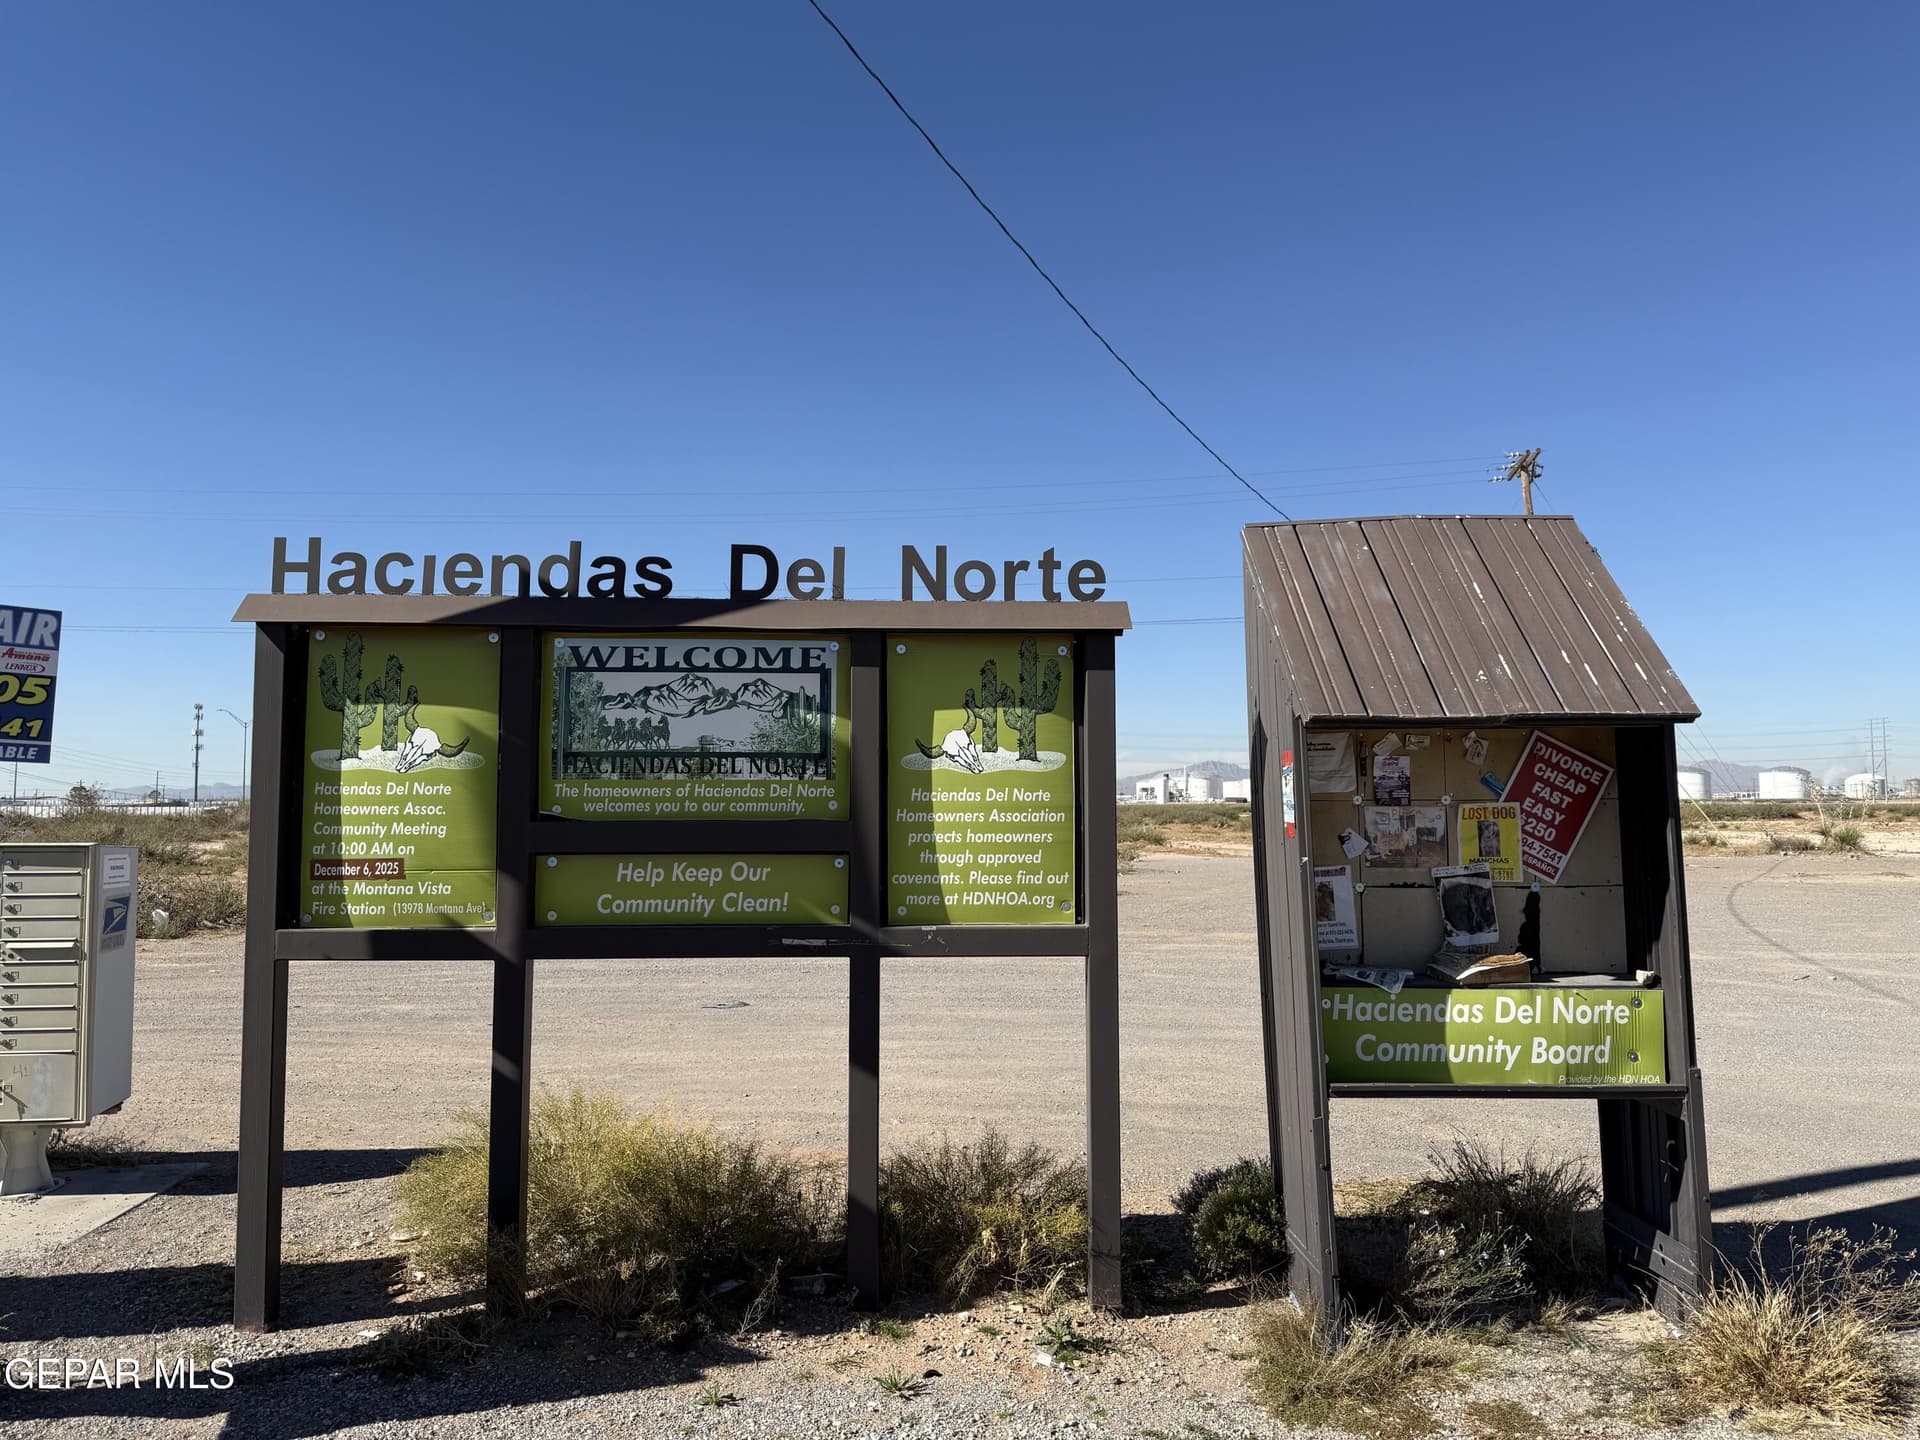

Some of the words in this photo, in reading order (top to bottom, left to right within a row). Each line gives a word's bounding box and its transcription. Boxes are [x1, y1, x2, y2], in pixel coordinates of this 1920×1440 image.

[270, 536, 674, 599] Haciendas
[730, 543, 846, 601] Del
[901, 544, 1107, 603] Norte
[566, 644, 828, 670] WELCOME
[562, 755, 692, 775] HACIENDAS
[699, 756, 742, 776] DEL
[749, 757, 827, 777] NORTE
[1533, 741, 1604, 785] DIVORCE
[1533, 762, 1587, 795] CHEAP
[314, 781, 382, 796] Haciendas
[386, 782, 409, 796] Del
[412, 782, 452, 796] Norte
[554, 783, 579, 798] The
[583, 783, 672, 798] homeowners
[676, 783, 692, 798] of
[694, 783, 765, 798] Haciendas
[769, 784, 792, 799] Del
[796, 785, 835, 799] Norte
[911, 788, 981, 802] Haciendas
[985, 788, 1009, 802] Del
[1012, 788, 1051, 802] Norte
[1531, 781, 1573, 809] FAST
[313, 802, 400, 816] Homeowners
[403, 802, 447, 816] Assoc.
[583, 799, 651, 813] welcomes
[655, 801, 681, 815] you
[685, 800, 699, 813] to
[702, 802, 726, 813] our
[729, 799, 806, 815] community.
[896, 808, 985, 823] Homeowners
[989, 808, 1065, 823] Association
[1461, 807, 1489, 820] LOST
[1492, 806, 1516, 820] DOG
[1522, 796, 1566, 826] EASY
[313, 822, 388, 838] Community
[390, 822, 448, 839] Meeting
[908, 829, 962, 846] protects
[966, 829, 1053, 843] homeowners
[312, 843, 326, 855] at
[330, 841, 367, 856] 10:00
[370, 841, 394, 855] AM
[397, 844, 415, 856] on
[919, 850, 974, 867] through
[977, 850, 1042, 867] approved
[1468, 857, 1510, 865] MANCHAS
[1523, 853, 1557, 876] ESPAÑOL
[314, 863, 360, 877] December
[363, 863, 373, 878] 6,
[375, 862, 400, 875] 2025
[616, 861, 665, 887] Help
[671, 862, 723, 887] Keep
[729, 861, 771, 883] Our
[891, 872, 965, 885] covenants.
[969, 871, 1013, 885] Please
[1016, 870, 1043, 885] find
[1046, 872, 1070, 885] out
[311, 882, 325, 895] at
[328, 882, 349, 896] the
[353, 882, 414, 896] Montana
[418, 881, 452, 895] Vista
[596, 893, 716, 917] Community
[721, 892, 789, 913] Clean!
[906, 894, 941, 905] more
[944, 892, 959, 905] at
[962, 891, 1056, 909] HDNHOA.org
[312, 902, 336, 915] Fire
[340, 902, 386, 916] Station
[393, 902, 424, 915] (13978
[425, 903, 464, 914] Montana
[1332, 993, 1485, 1025] Haciendas
[1494, 995, 1542, 1025] Del
[1552, 996, 1632, 1026] Norte
[1355, 1034, 1522, 1071] Community
[1530, 1035, 1612, 1065] Board
[1558, 1074, 1592, 1084] Provided
[1592, 1074, 1603, 1086] by
[1603, 1074, 1617, 1084] the
[1618, 1074, 1639, 1084] HDN
[1639, 1074, 1661, 1085] HOA
